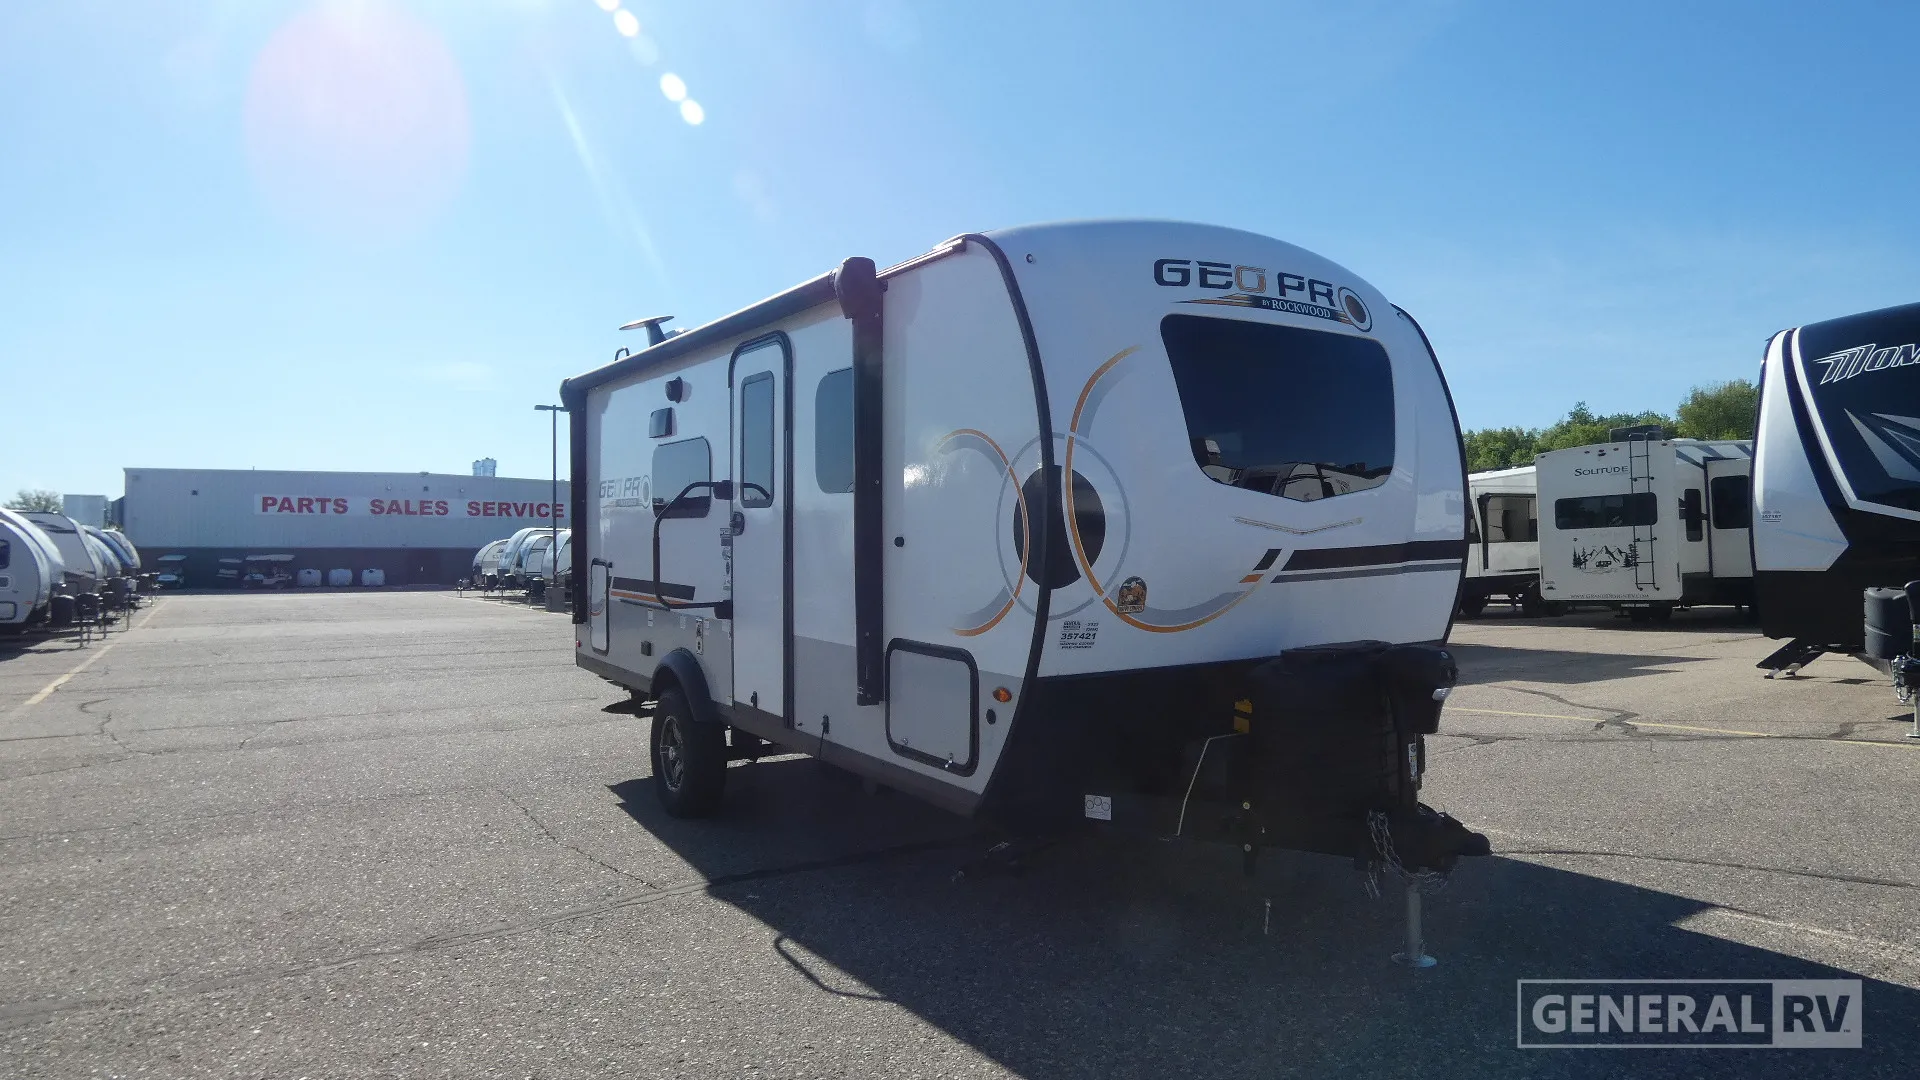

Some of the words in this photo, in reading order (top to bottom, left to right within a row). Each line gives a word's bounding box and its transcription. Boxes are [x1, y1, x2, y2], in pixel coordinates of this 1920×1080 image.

[1153, 258, 1266, 293] GEO
[1277, 271, 1373, 333] PRO
[1272, 300, 1331, 318] ROCKWOOD
[261, 496, 349, 514] PARTS
[369, 499, 449, 516] SALES
[466, 501, 565, 518] SERVICE
[1060, 632, 1097, 640] 357421
